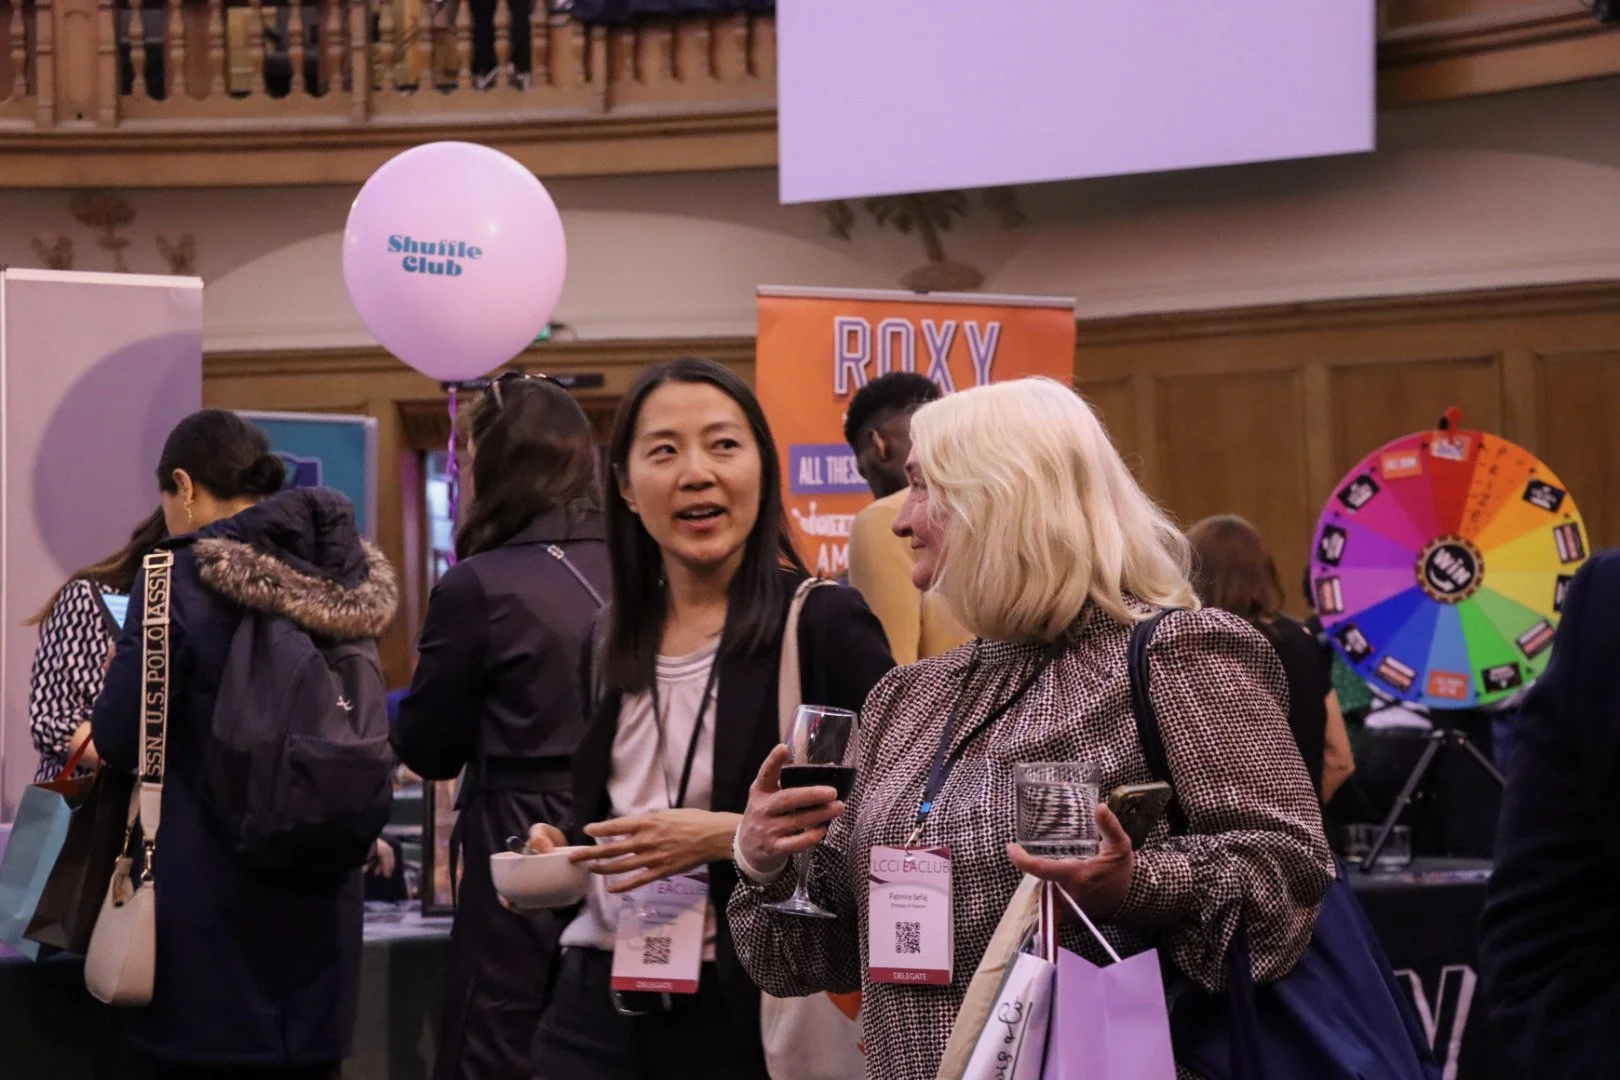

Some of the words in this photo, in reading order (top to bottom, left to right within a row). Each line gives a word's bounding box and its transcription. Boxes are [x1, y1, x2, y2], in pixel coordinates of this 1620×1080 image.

[387, 233, 483, 259] Shuffle
[401, 255, 463, 276] Club
[833, 315, 1001, 397] ROXY
[798, 455, 824, 486] ALL
[147, 626, 166, 682] POLO
[146, 686, 165, 725] U.S.
[893, 971, 928, 981] DELEGATE
